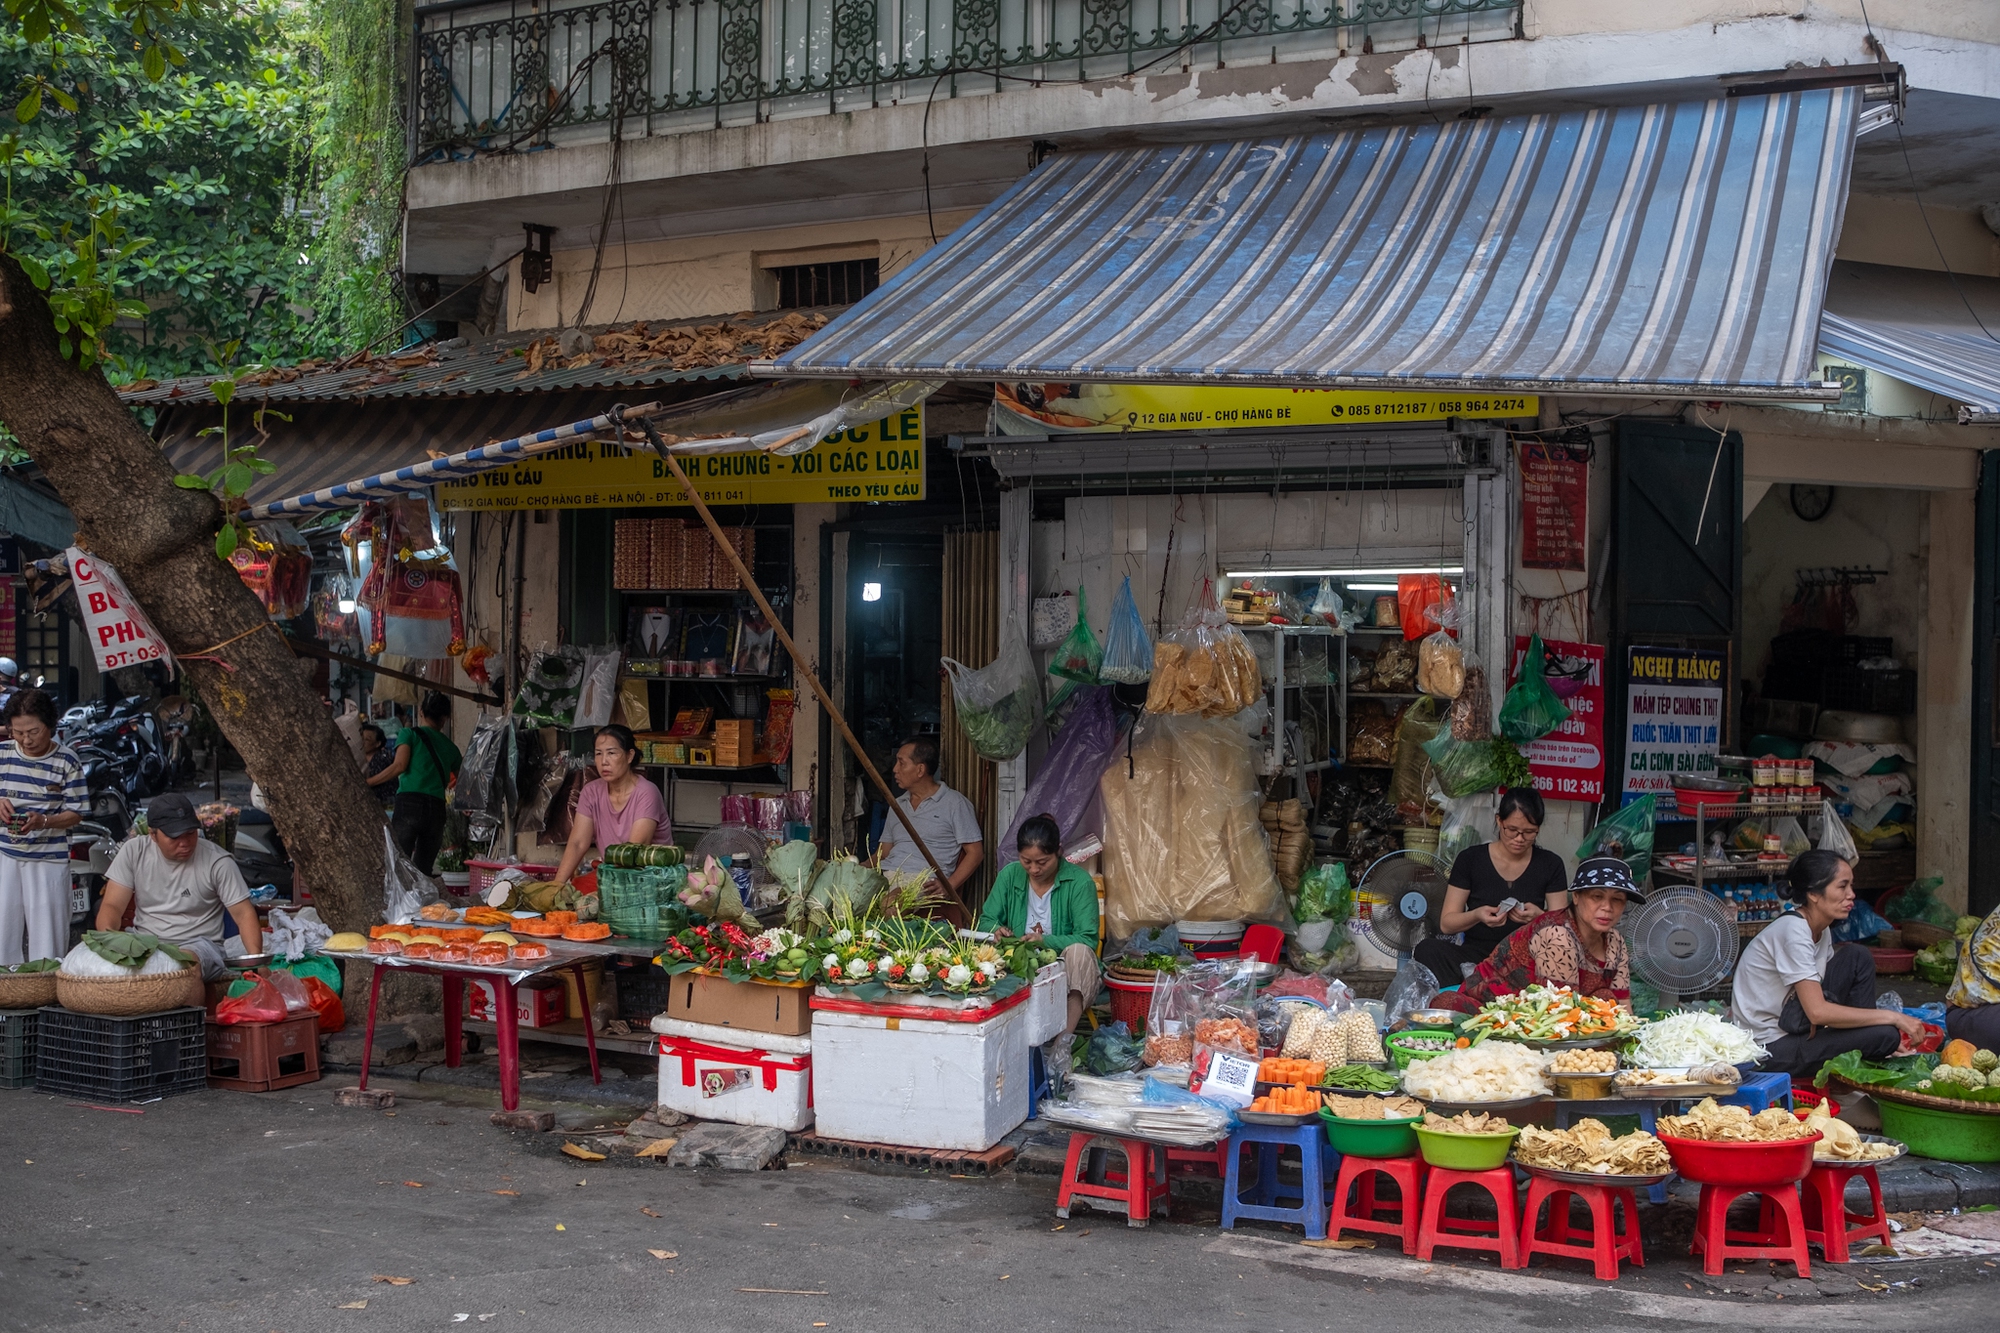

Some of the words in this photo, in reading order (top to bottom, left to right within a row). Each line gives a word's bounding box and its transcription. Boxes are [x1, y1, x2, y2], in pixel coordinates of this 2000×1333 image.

[1142, 414, 1154, 423] 12
[1159, 412, 1176, 423] GIA
[1180, 410, 1203, 422] NGƯ
[1215, 409, 1238, 423] CHỢ
[1242, 407, 1272, 420] HÀNG
[1277, 406, 1291, 419] BÈ
[1348, 405, 1370, 416] 085
[1374, 403, 1427, 415] 8712187
[1439, 401, 1461, 412] 058
[1466, 400, 1489, 411] 964
[1493, 399, 1524, 411] 2474
[707, 453, 770, 477] CHƯNG
[792, 451, 822, 473] XÔI
[829, 447, 867, 472] CÁC
[876, 450, 919, 475] LOẠI
[483, 470, 509, 487] YÊU
[443, 500, 461, 508] ĐC:
[463, 499, 473, 507] 12
[476, 498, 493, 507] GIA
[527, 496, 549, 508] CHỢ
[552, 494, 582, 505] HÀNG
[585, 494, 599, 505] BÈ
[609, 493, 624, 504] HÀ
[627, 491, 645, 504] NỘI
[656, 492, 673, 502] ĐT:
[676, 491, 701, 501] 09
[704, 491, 723, 501] 811
[725, 490, 744, 500] 041
[828, 486, 860, 498] THEO
[865, 483, 892, 497] YÊU
[105, 651, 134, 668] ĐT:
[137, 645, 159, 661] 03
[1632, 655, 1673, 683] NGHỊ
[1568, 697, 1594, 715] việc
[1657, 693, 1671, 715] TÉP
[1703, 697, 1718, 720] THỊT
[1632, 719, 1656, 743] RUỐC
[1658, 722, 1681, 743] THĂN
[1683, 725, 1701, 748] THỊT
[1570, 745, 1595, 754] facebook
[1630, 750, 1647, 771] CÁ
[1650, 751, 1674, 771] CƠM
[1677, 750, 1694, 771] SÀI
[1697, 750, 1715, 771] GÒN
[1532, 775, 1553, 791] 366
[1557, 777, 1577, 792] 102
[1580, 779, 1601, 795] 341
[73, 890, 84, 900] H9
[73, 900, 85, 911] 99
[516, 1009, 529, 1020] 00
